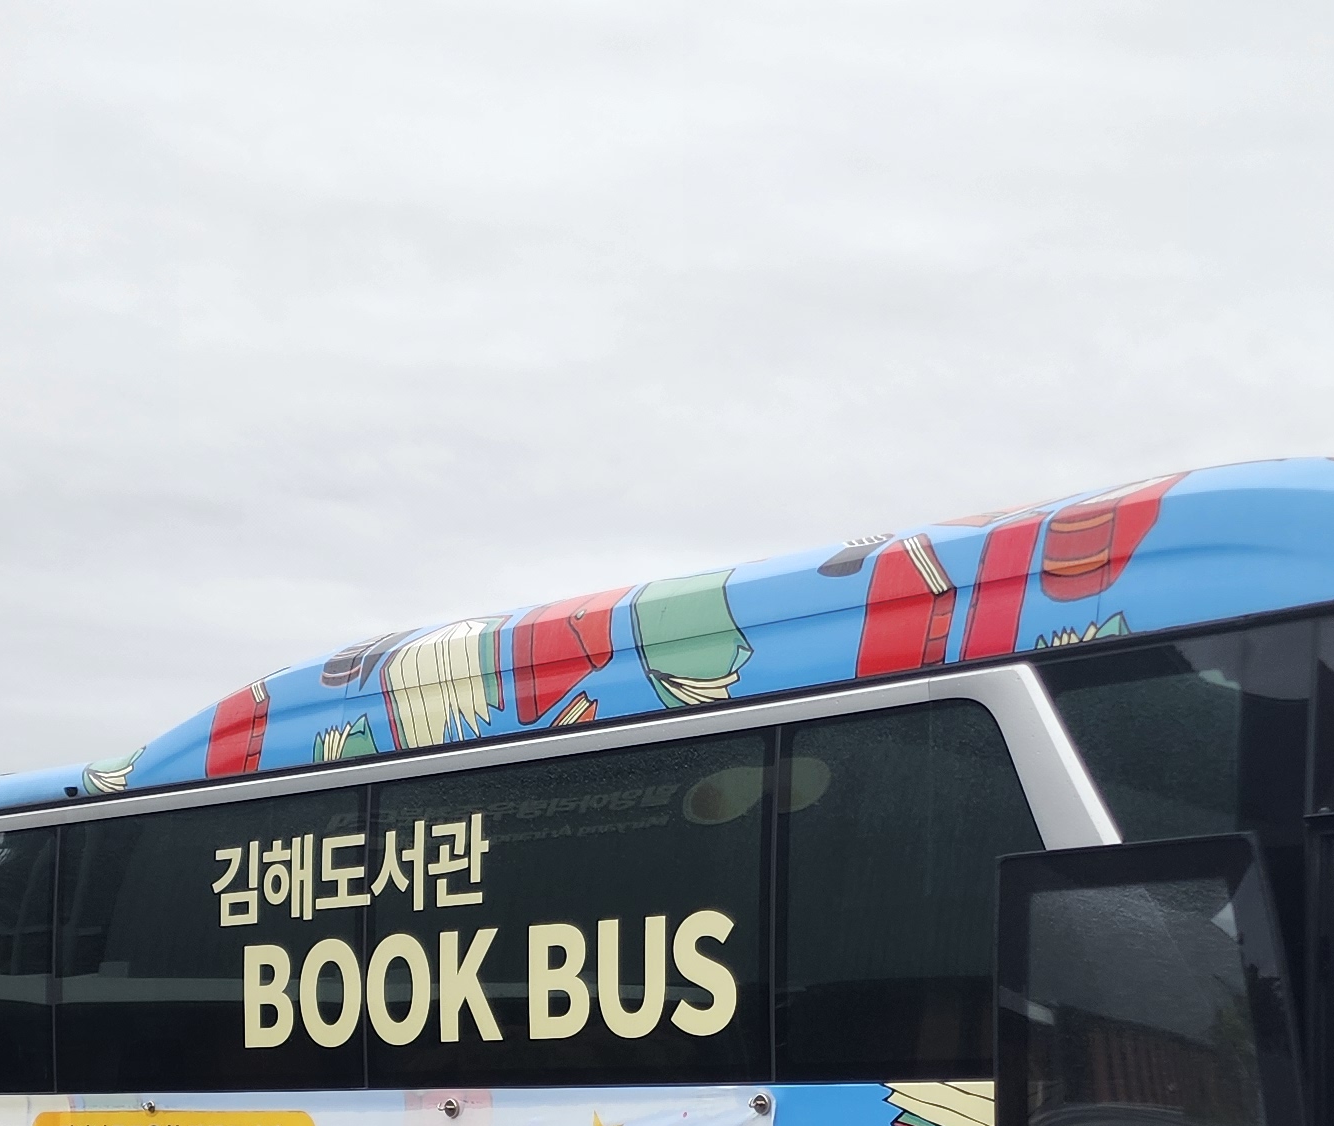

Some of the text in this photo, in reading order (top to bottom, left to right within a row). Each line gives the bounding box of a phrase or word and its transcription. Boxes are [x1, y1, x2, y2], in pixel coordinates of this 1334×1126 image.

[212, 813, 490, 926] 김해도서관
[244, 909, 738, 1048] BOOK BUS
